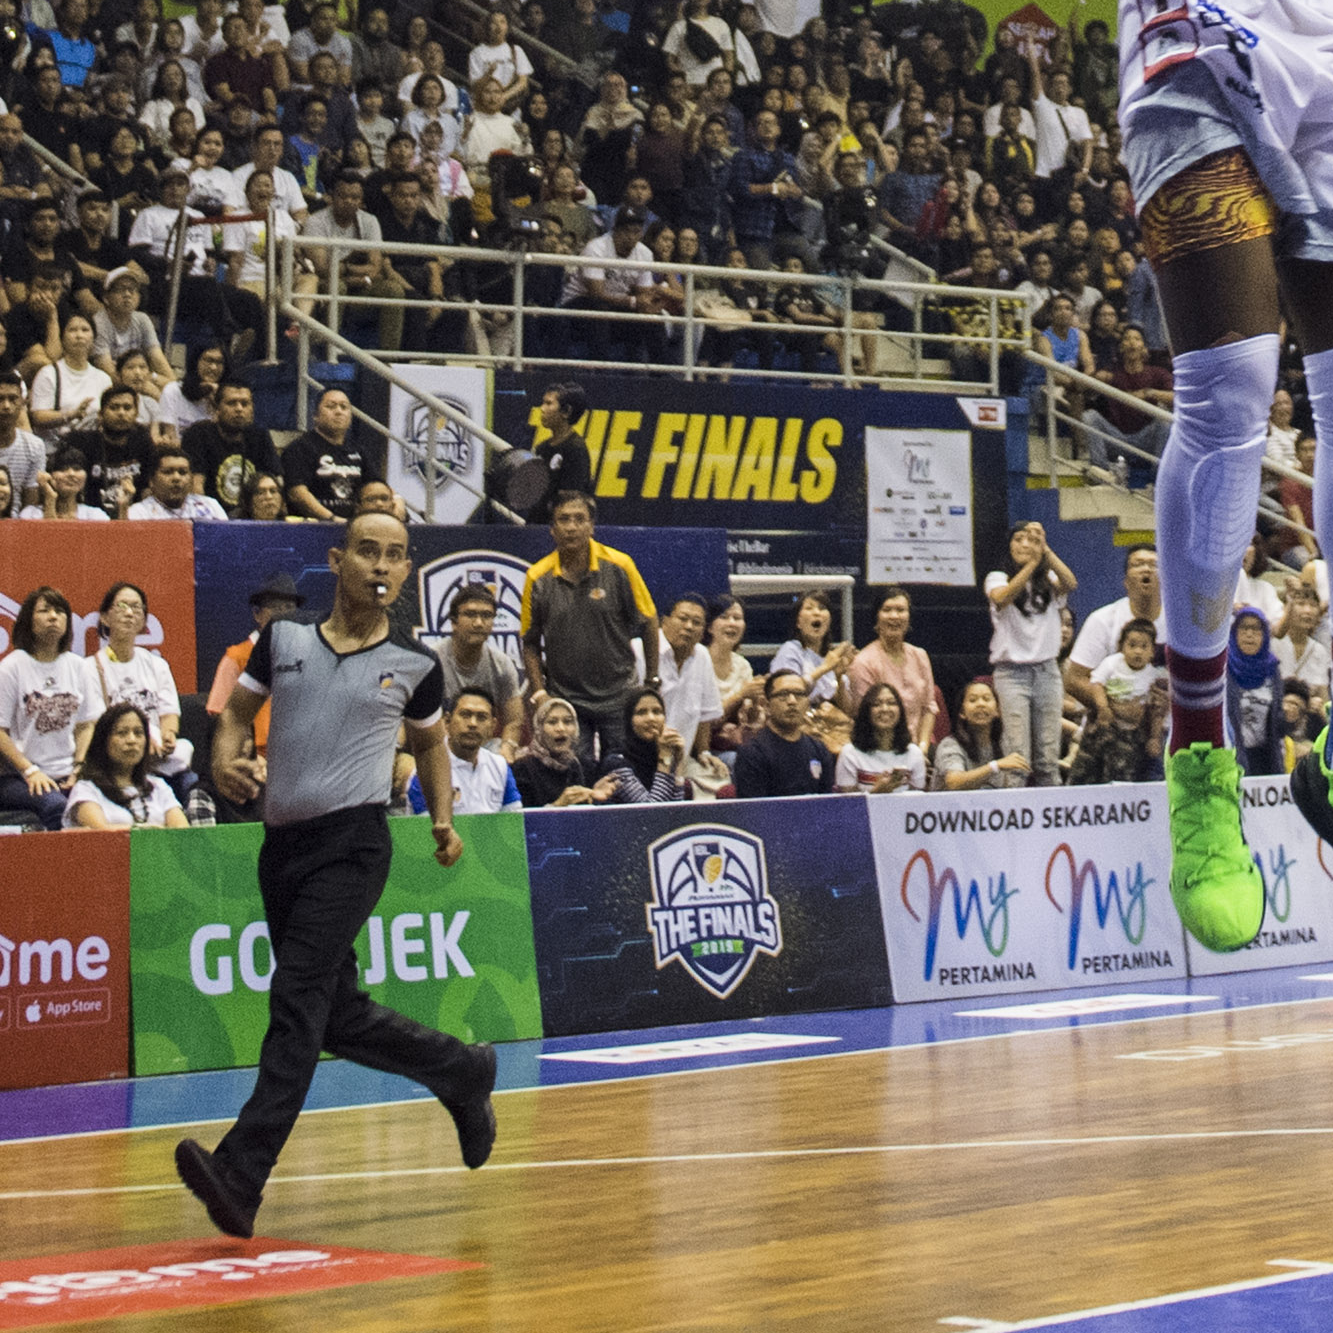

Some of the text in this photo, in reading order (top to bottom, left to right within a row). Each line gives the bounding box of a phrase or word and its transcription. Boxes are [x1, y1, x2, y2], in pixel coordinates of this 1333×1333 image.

[641, 412, 843, 504] FINALS
[904, 799, 1152, 835] DOWNLOAD SEKARANG
[653, 902, 778, 956] THE FINALS
[1246, 926, 1318, 950] ERTAMINA
[189, 910, 476, 996] GO JEK
[938, 949, 1174, 986] PERTAMINA PERTAMINA
[47, 998, 102, 1018] App Store
